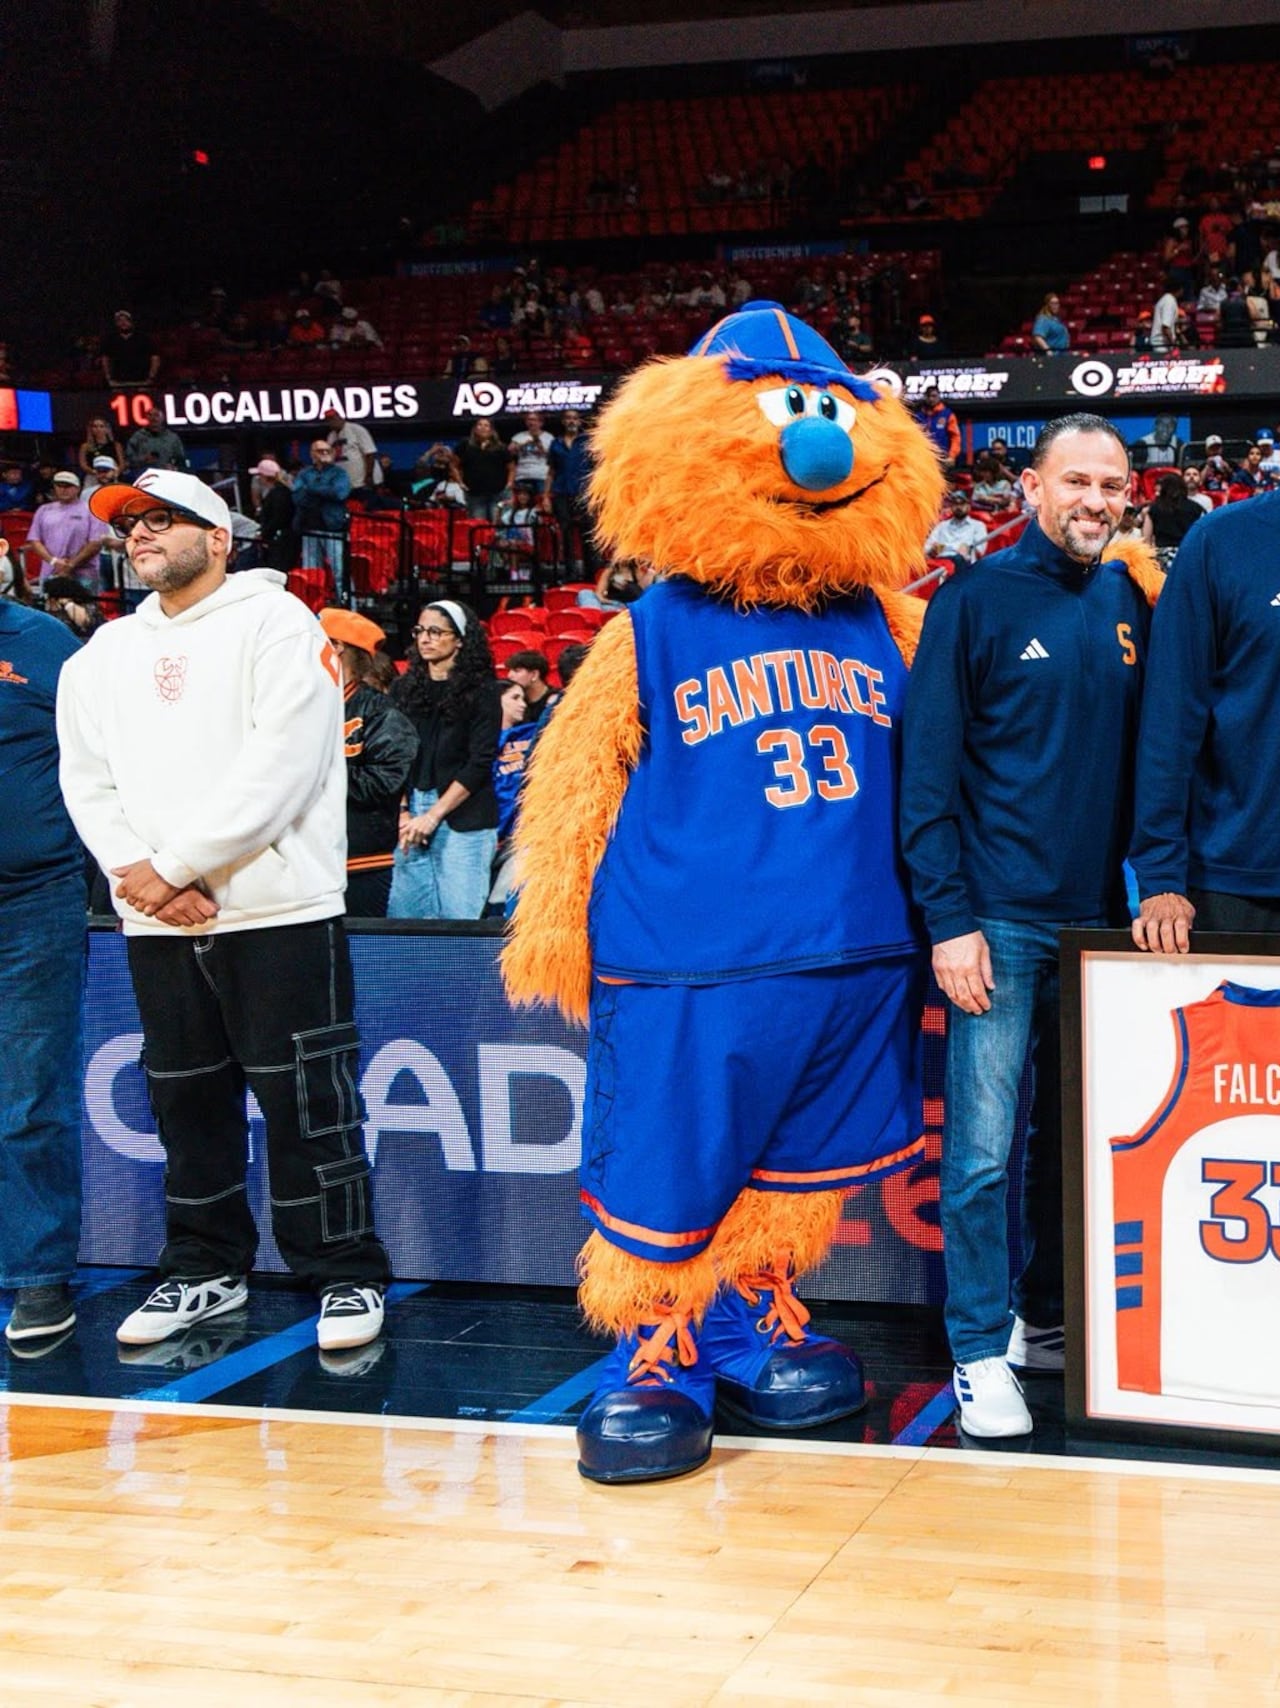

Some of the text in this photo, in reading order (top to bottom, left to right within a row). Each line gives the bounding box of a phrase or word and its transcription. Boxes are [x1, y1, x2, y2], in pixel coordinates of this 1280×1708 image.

[506, 386, 602, 406] TARGET
[906, 372, 1009, 394] TARGET
[1116, 365, 1224, 386] TARGET
[110, 385, 419, 427] 10 LOCALIDADES
[1116, 623, 1137, 665] S
[673, 649, 893, 746] SANTURCE
[755, 724, 860, 810] 33
